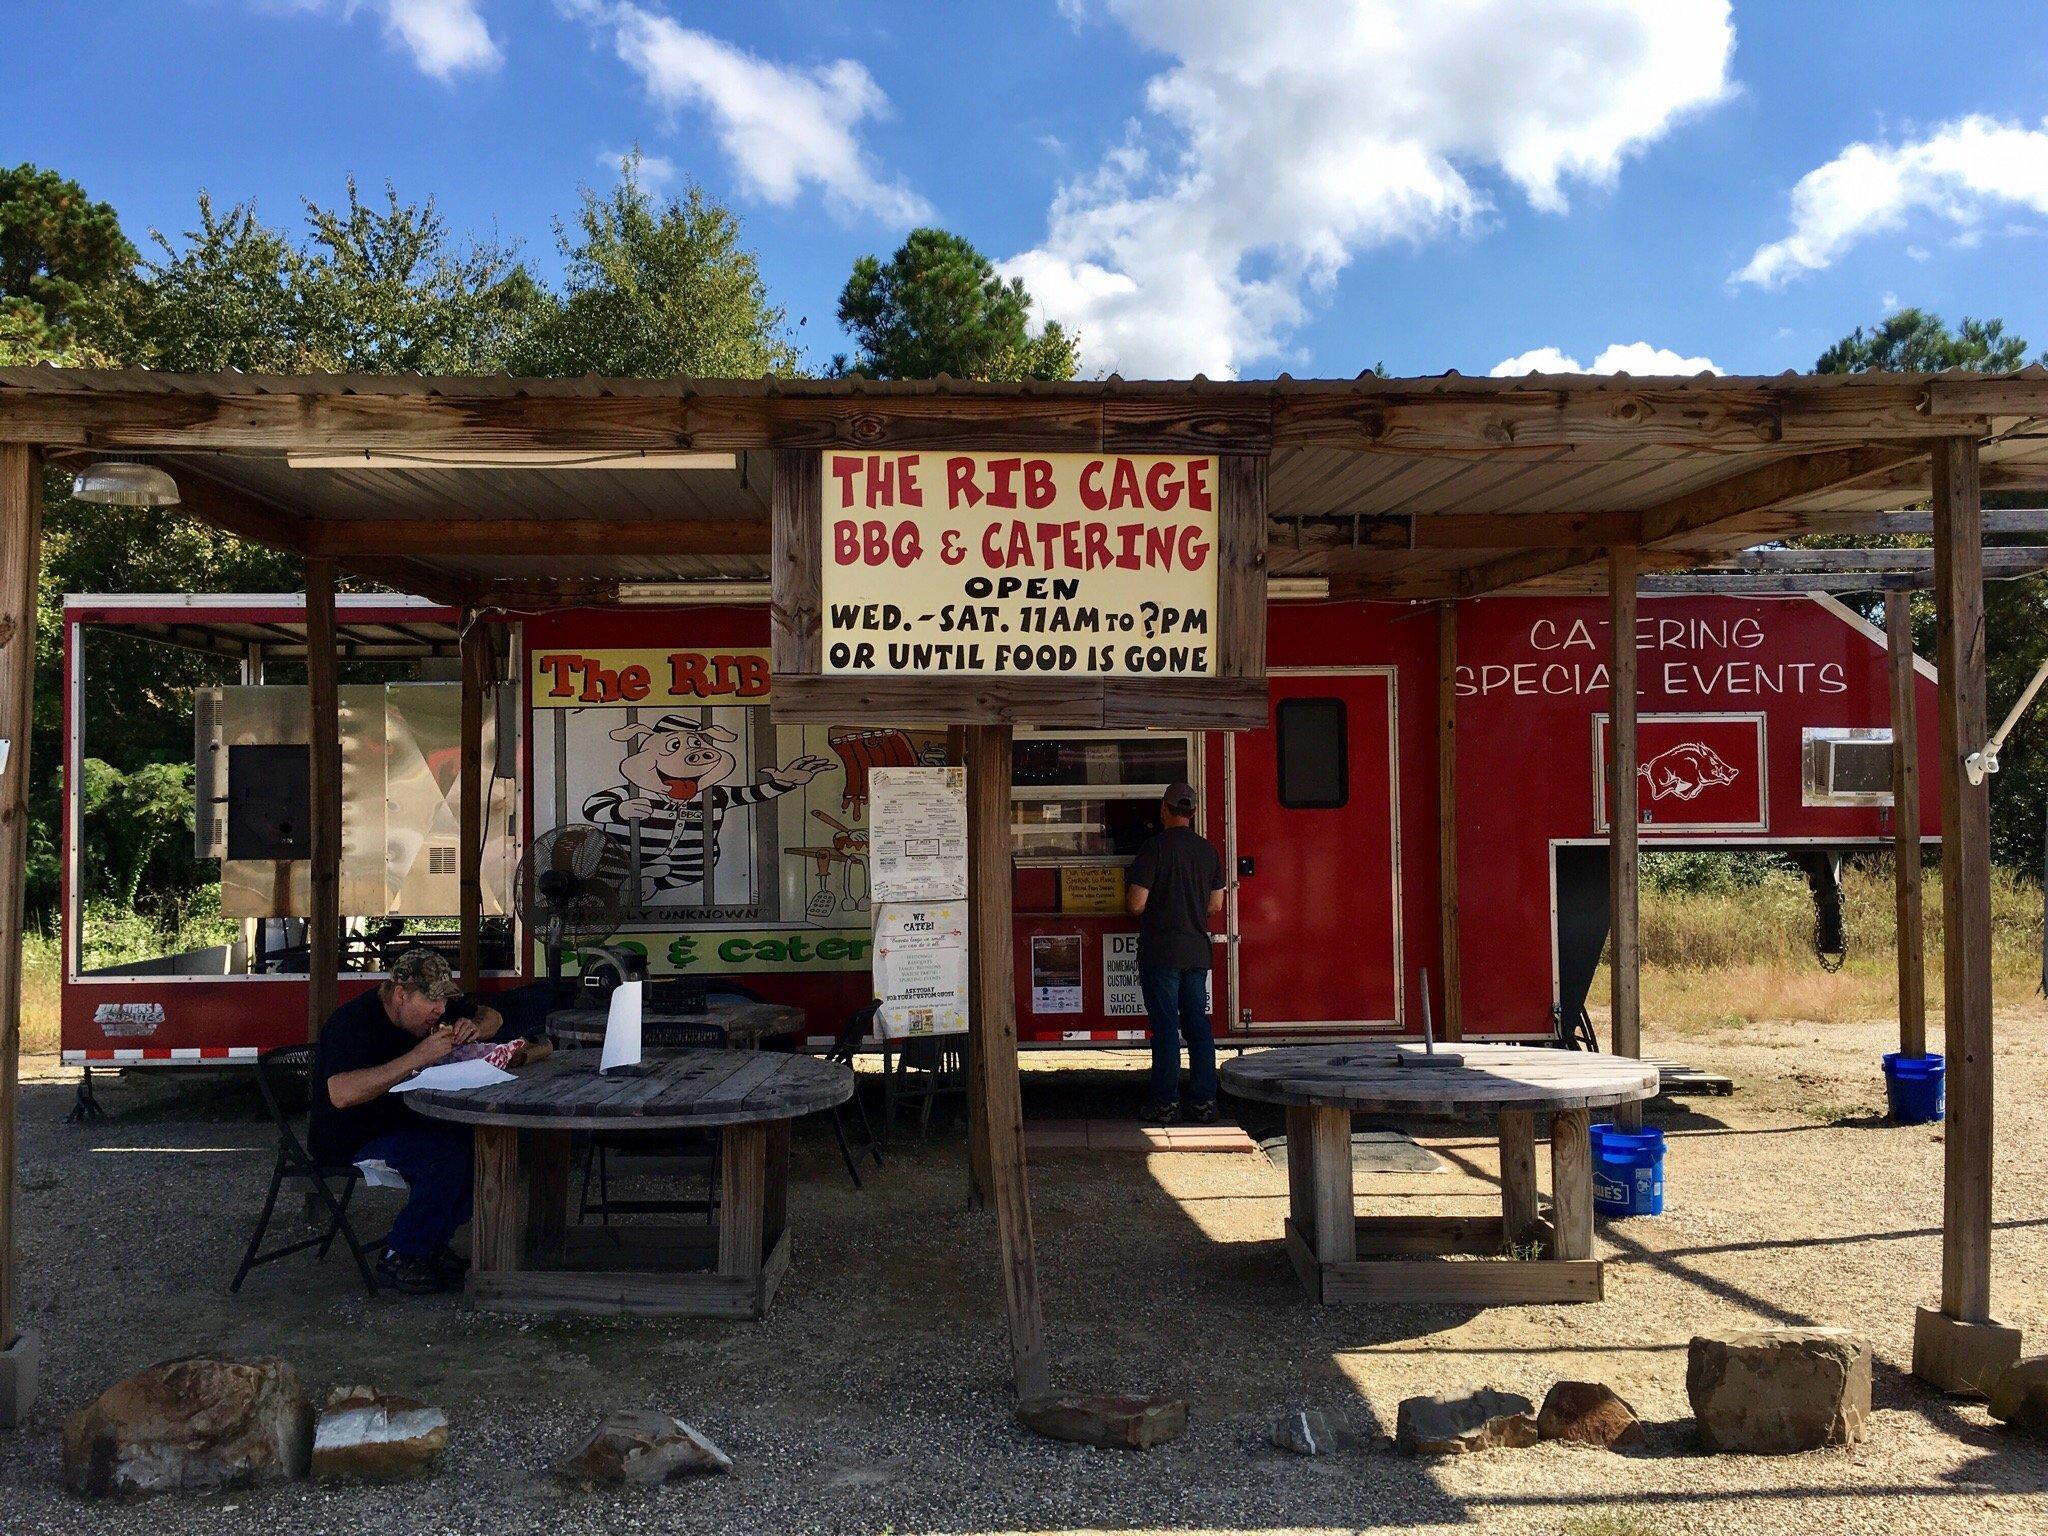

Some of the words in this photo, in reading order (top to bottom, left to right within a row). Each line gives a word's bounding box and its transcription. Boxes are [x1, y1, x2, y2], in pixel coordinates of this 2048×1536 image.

[832, 454, 923, 510] THE
[946, 456, 1057, 511] RIB
[1078, 457, 1212, 512] CAGE
[833, 519, 924, 568] BBQ
[940, 529, 968, 566] &
[981, 519, 1210, 573] CATERING
[964, 576, 1080, 600] OPEN
[1020, 606, 1099, 633] 11AM
[1105, 612, 1134, 632] TO
[1530, 617, 1765, 651] CAERING
[829, 642, 875, 670] OR
[888, 642, 985, 671] UNTIL
[995, 644, 1078, 671] FOOD
[1087, 645, 1115, 671] IS
[1124, 645, 1208, 673] GONE
[540, 653, 651, 703] The
[667, 652, 771, 699] RIB
[1456, 663, 1645, 696] SPECIA
[1665, 661, 1848, 695] EVENTS
[680, 810, 703, 819] BBQ
[913, 913, 925, 921] WE
[1107, 960, 1140, 973] HOMEMAD
[1107, 974, 1132, 987] CUSTOM
[913, 992, 937, 1000] CUSTOM
[917, 986, 935, 994] TODAY
[1110, 993, 1136, 1003] SLICE
[1110, 1004, 1143, 1014] WHOLE
